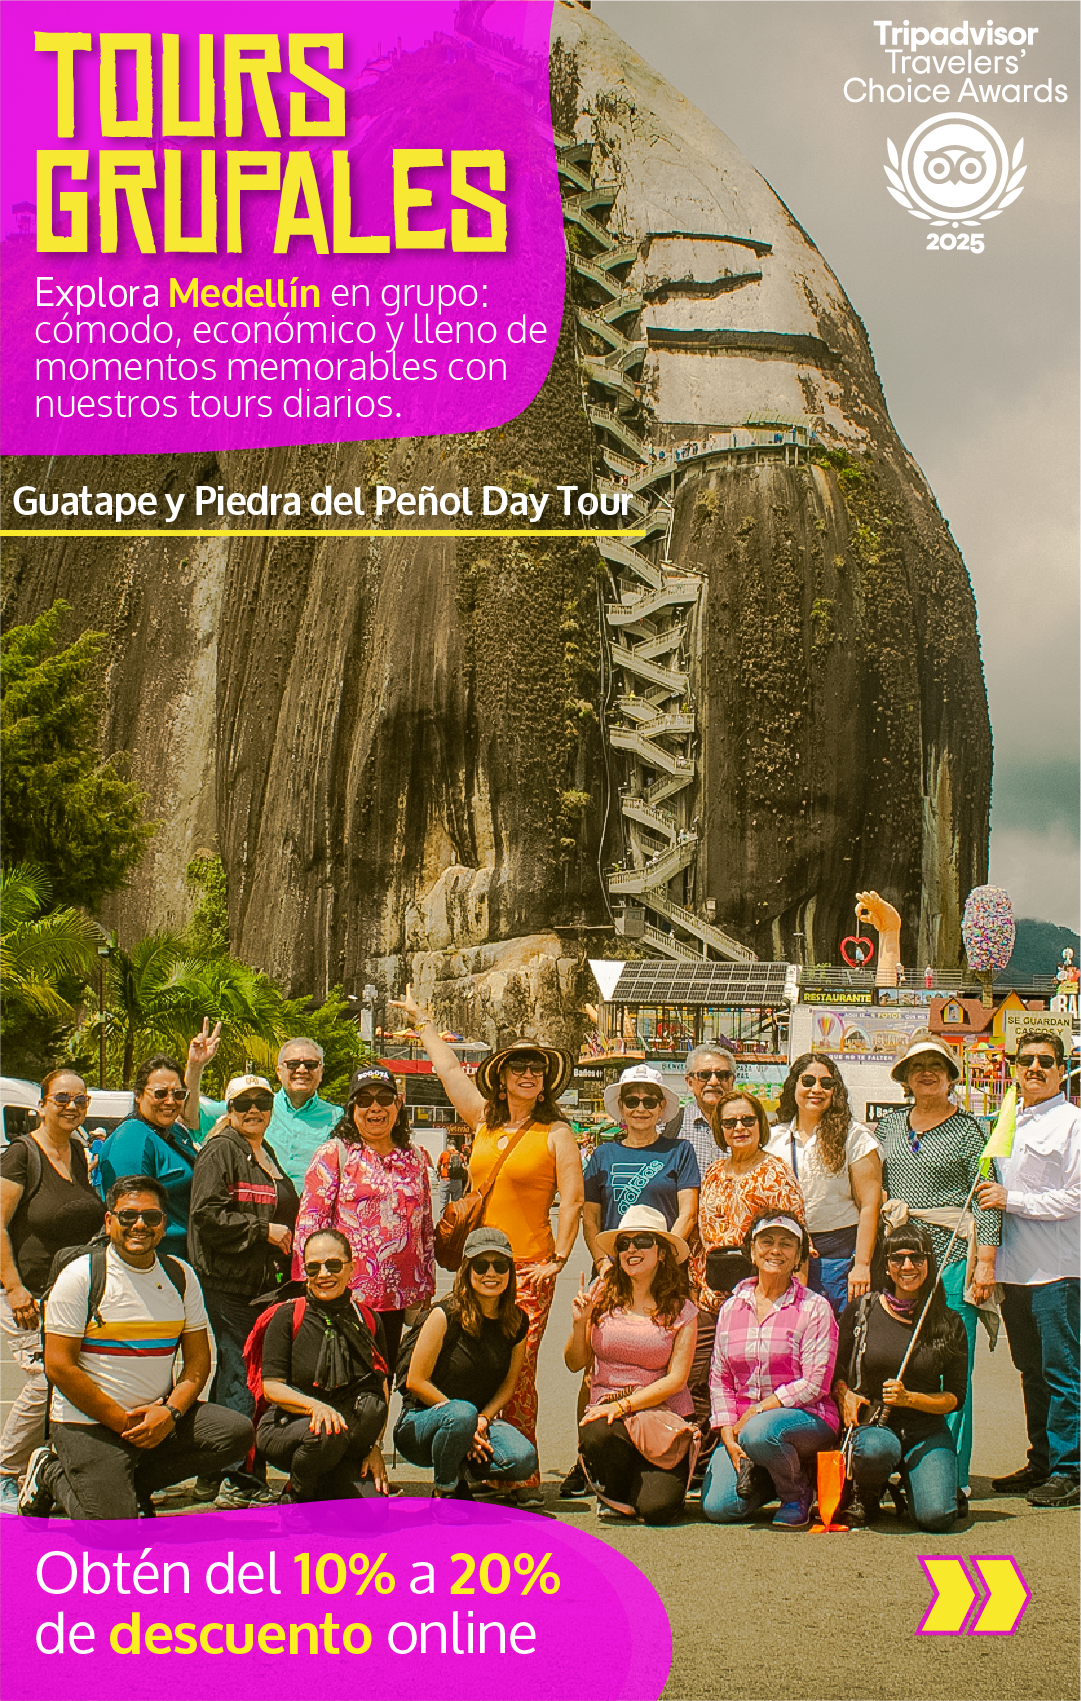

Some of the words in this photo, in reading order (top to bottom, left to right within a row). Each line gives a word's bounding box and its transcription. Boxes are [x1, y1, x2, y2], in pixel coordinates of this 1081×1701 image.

[803, 993, 871, 1003] RESTAURANTE
[1007, 1015, 1020, 1024] SE
[1023, 1016, 1070, 1026] GUARDAN
